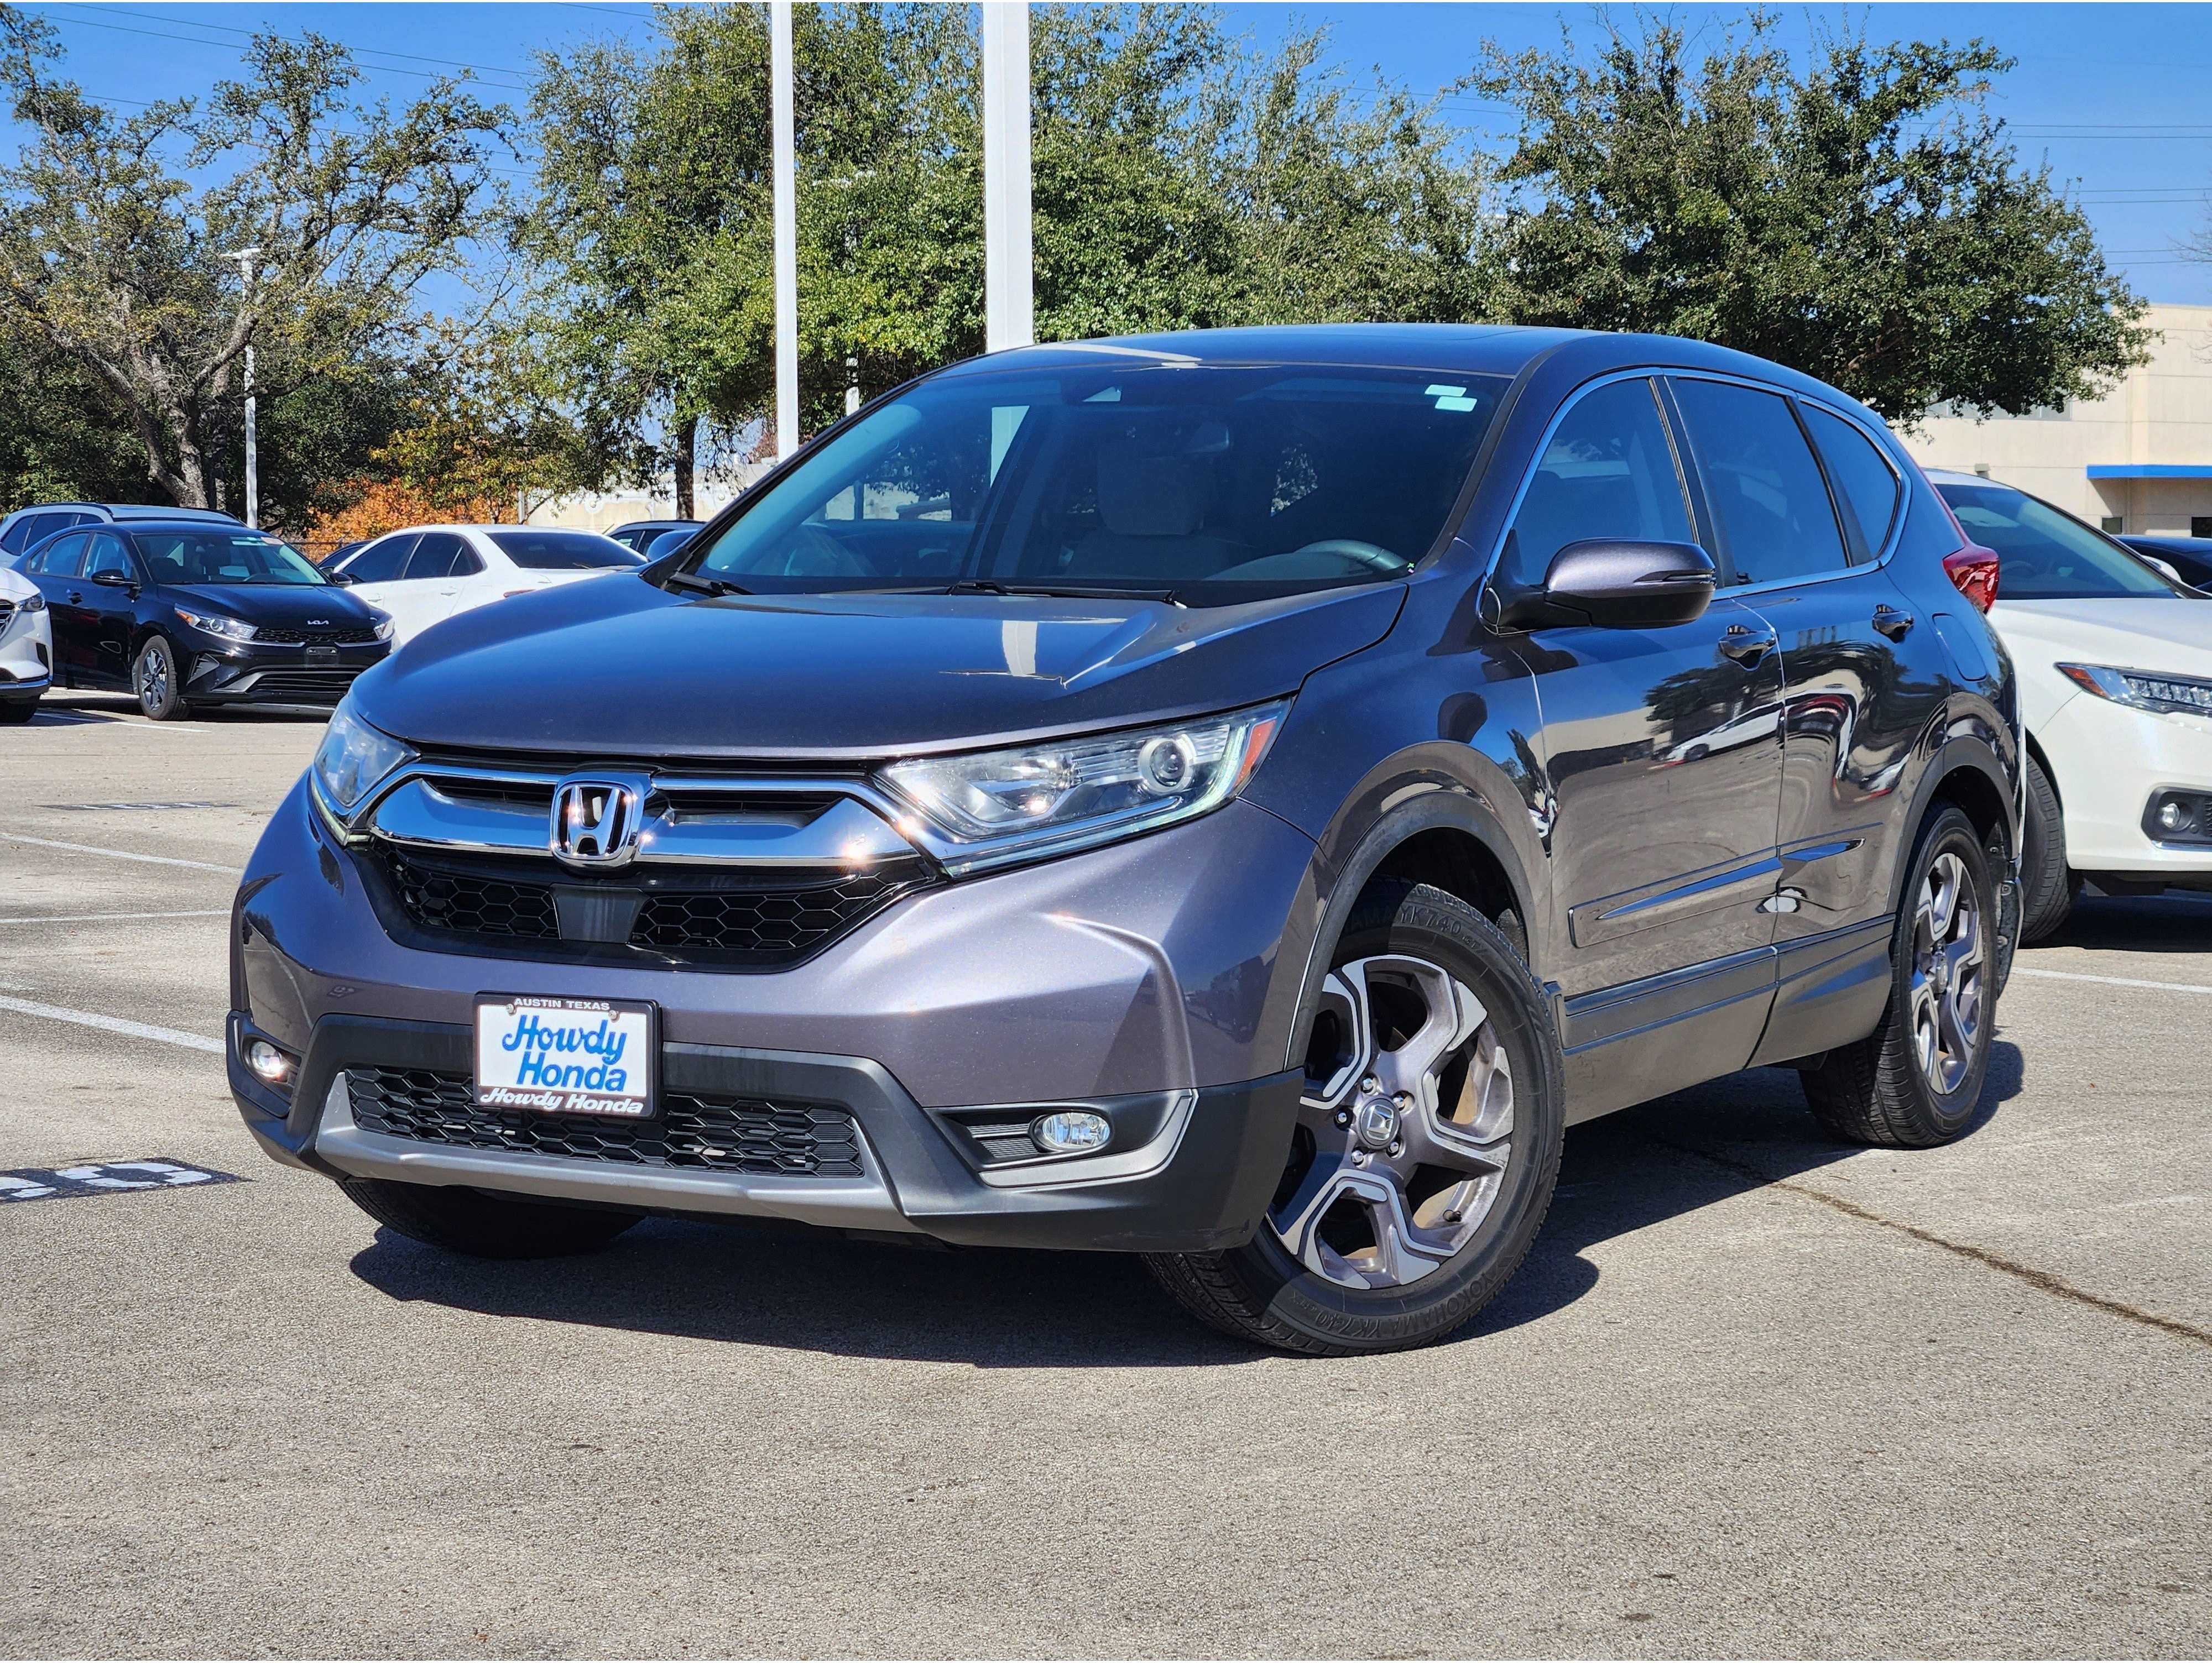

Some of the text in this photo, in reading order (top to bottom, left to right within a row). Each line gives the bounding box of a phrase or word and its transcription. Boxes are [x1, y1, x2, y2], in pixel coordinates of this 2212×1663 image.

[514, 998, 610, 1011] AUSTIN TEXAS
[502, 1014, 628, 1065] Howdy
[517, 1051, 627, 1092] Honda
[481, 1087, 644, 1113] Howdy Honda
[1391, 1273, 1493, 1337] YOKOHAMA
